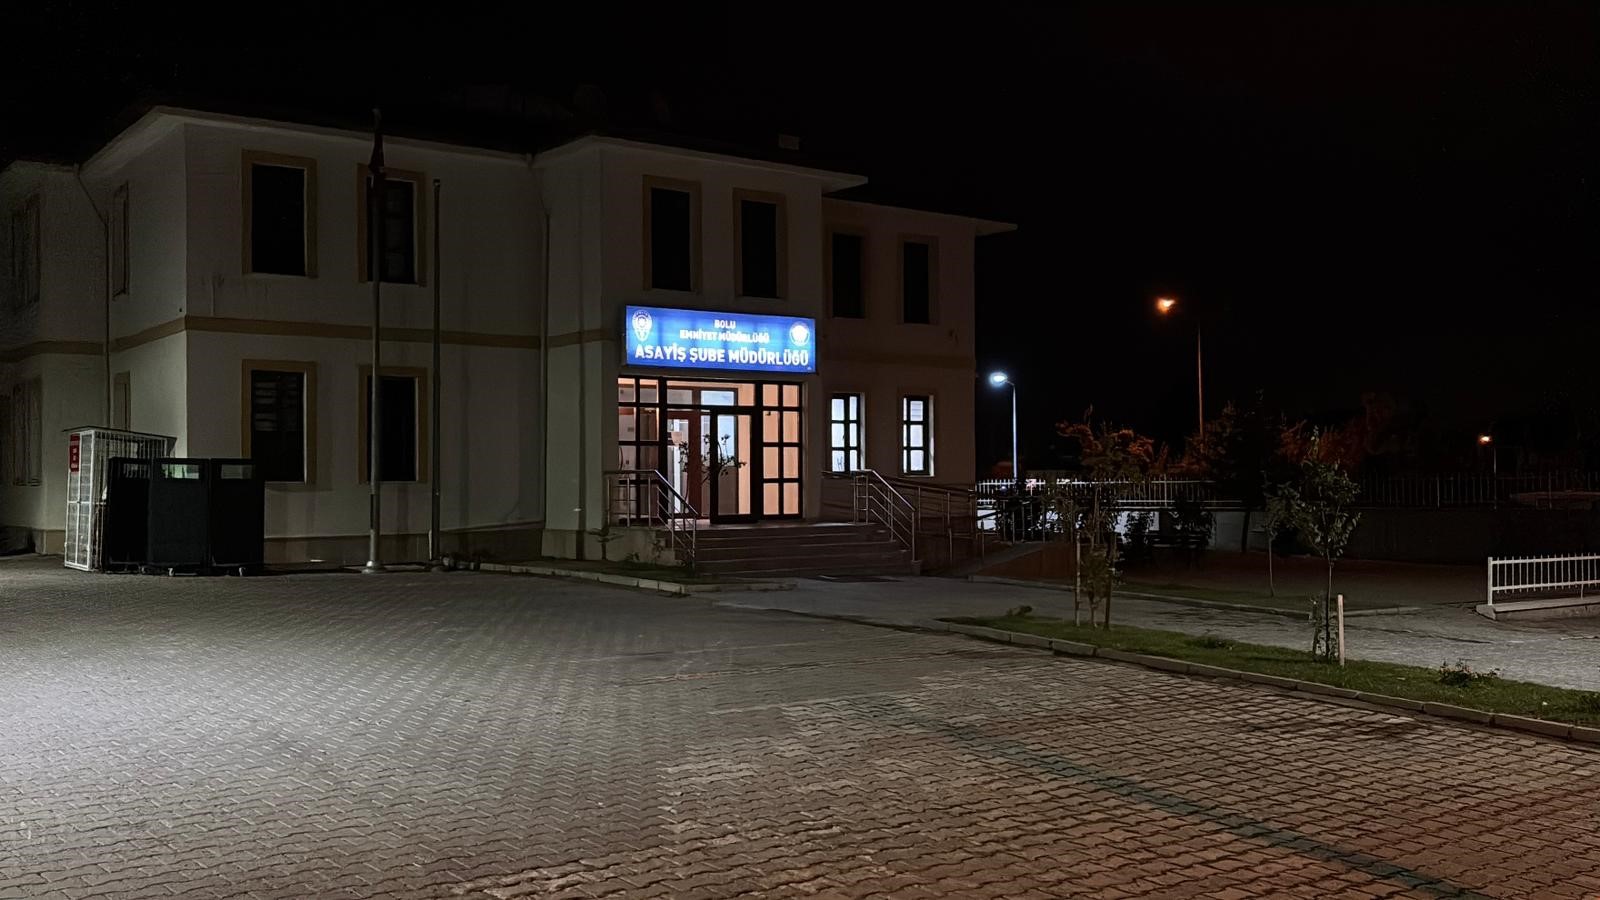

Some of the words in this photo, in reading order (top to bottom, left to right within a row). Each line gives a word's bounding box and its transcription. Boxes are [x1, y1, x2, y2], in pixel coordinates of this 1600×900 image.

[714, 319, 736, 329] BOLU
[679, 329, 717, 341] EMNİYET
[635, 343, 686, 362] ASAYİŞ
[690, 347, 725, 363] ŞUBE
[729, 348, 809, 366] MÜDÜRLÜĞÜ
